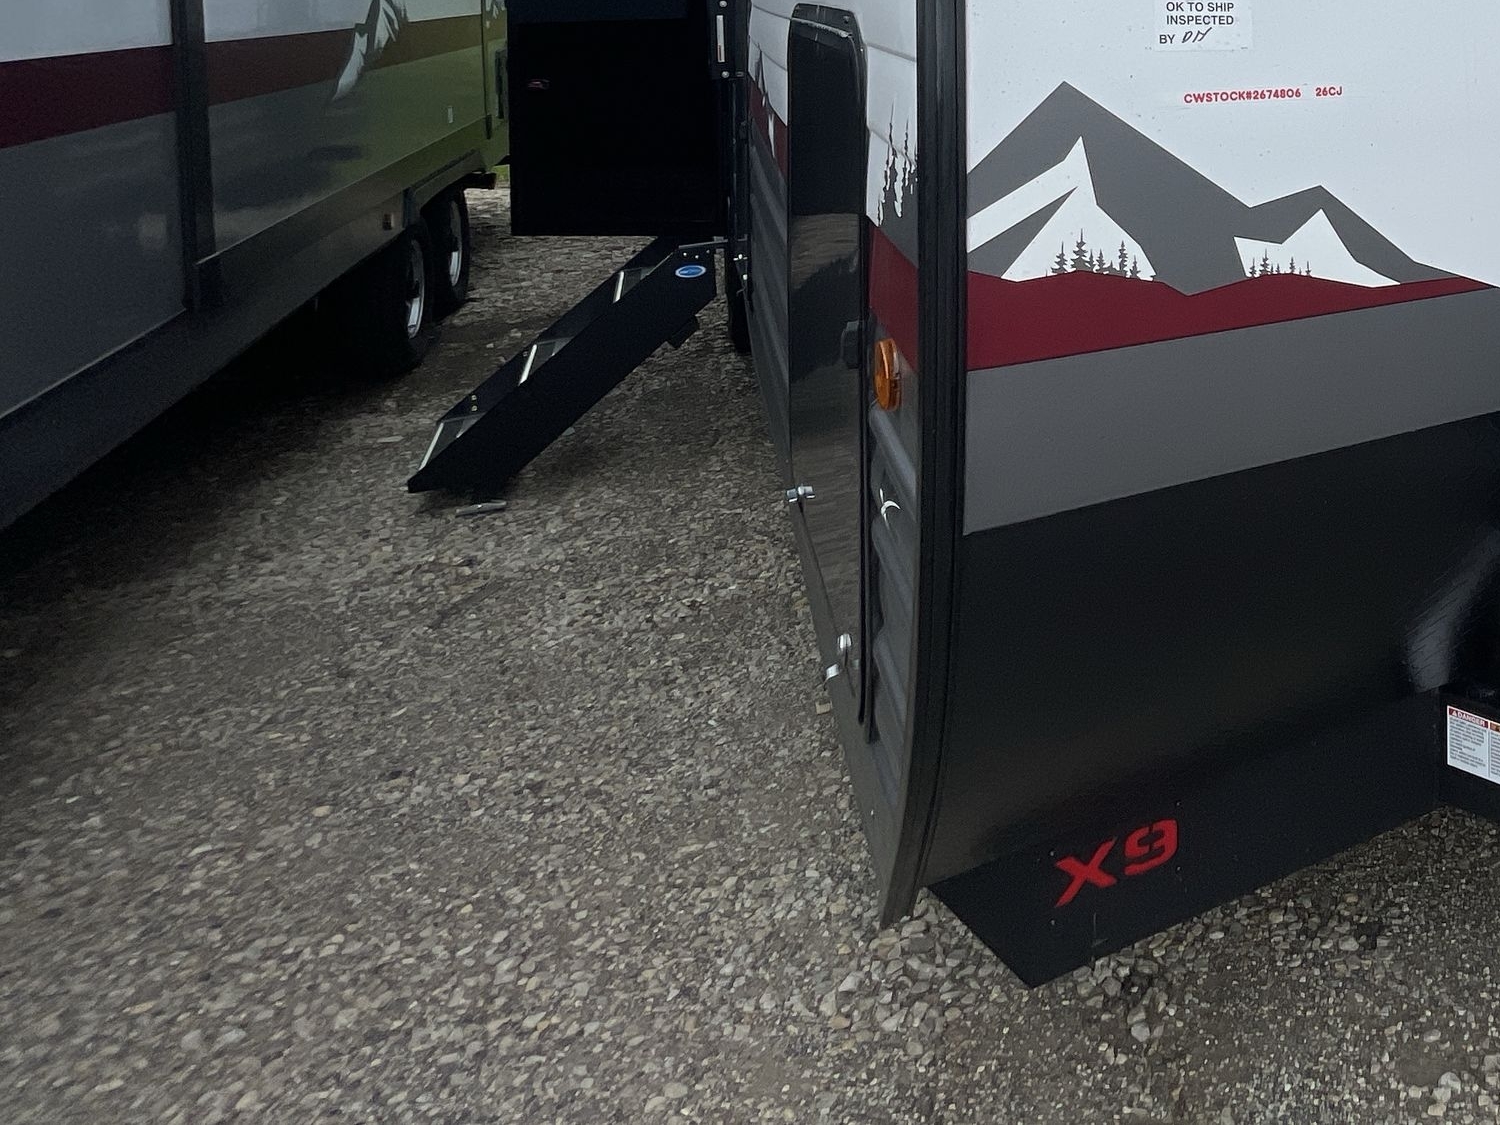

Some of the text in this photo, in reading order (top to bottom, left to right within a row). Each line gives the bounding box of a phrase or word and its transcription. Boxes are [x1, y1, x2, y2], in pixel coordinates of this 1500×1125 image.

[1166, 2, 1234, 12] OK TO SHIP
[1166, 15, 1234, 25] INSPECTED
[1159, 34, 1175, 44] BY
[1315, 86, 1343, 97] 26CJ
[1055, 818, 1178, 908] X9
